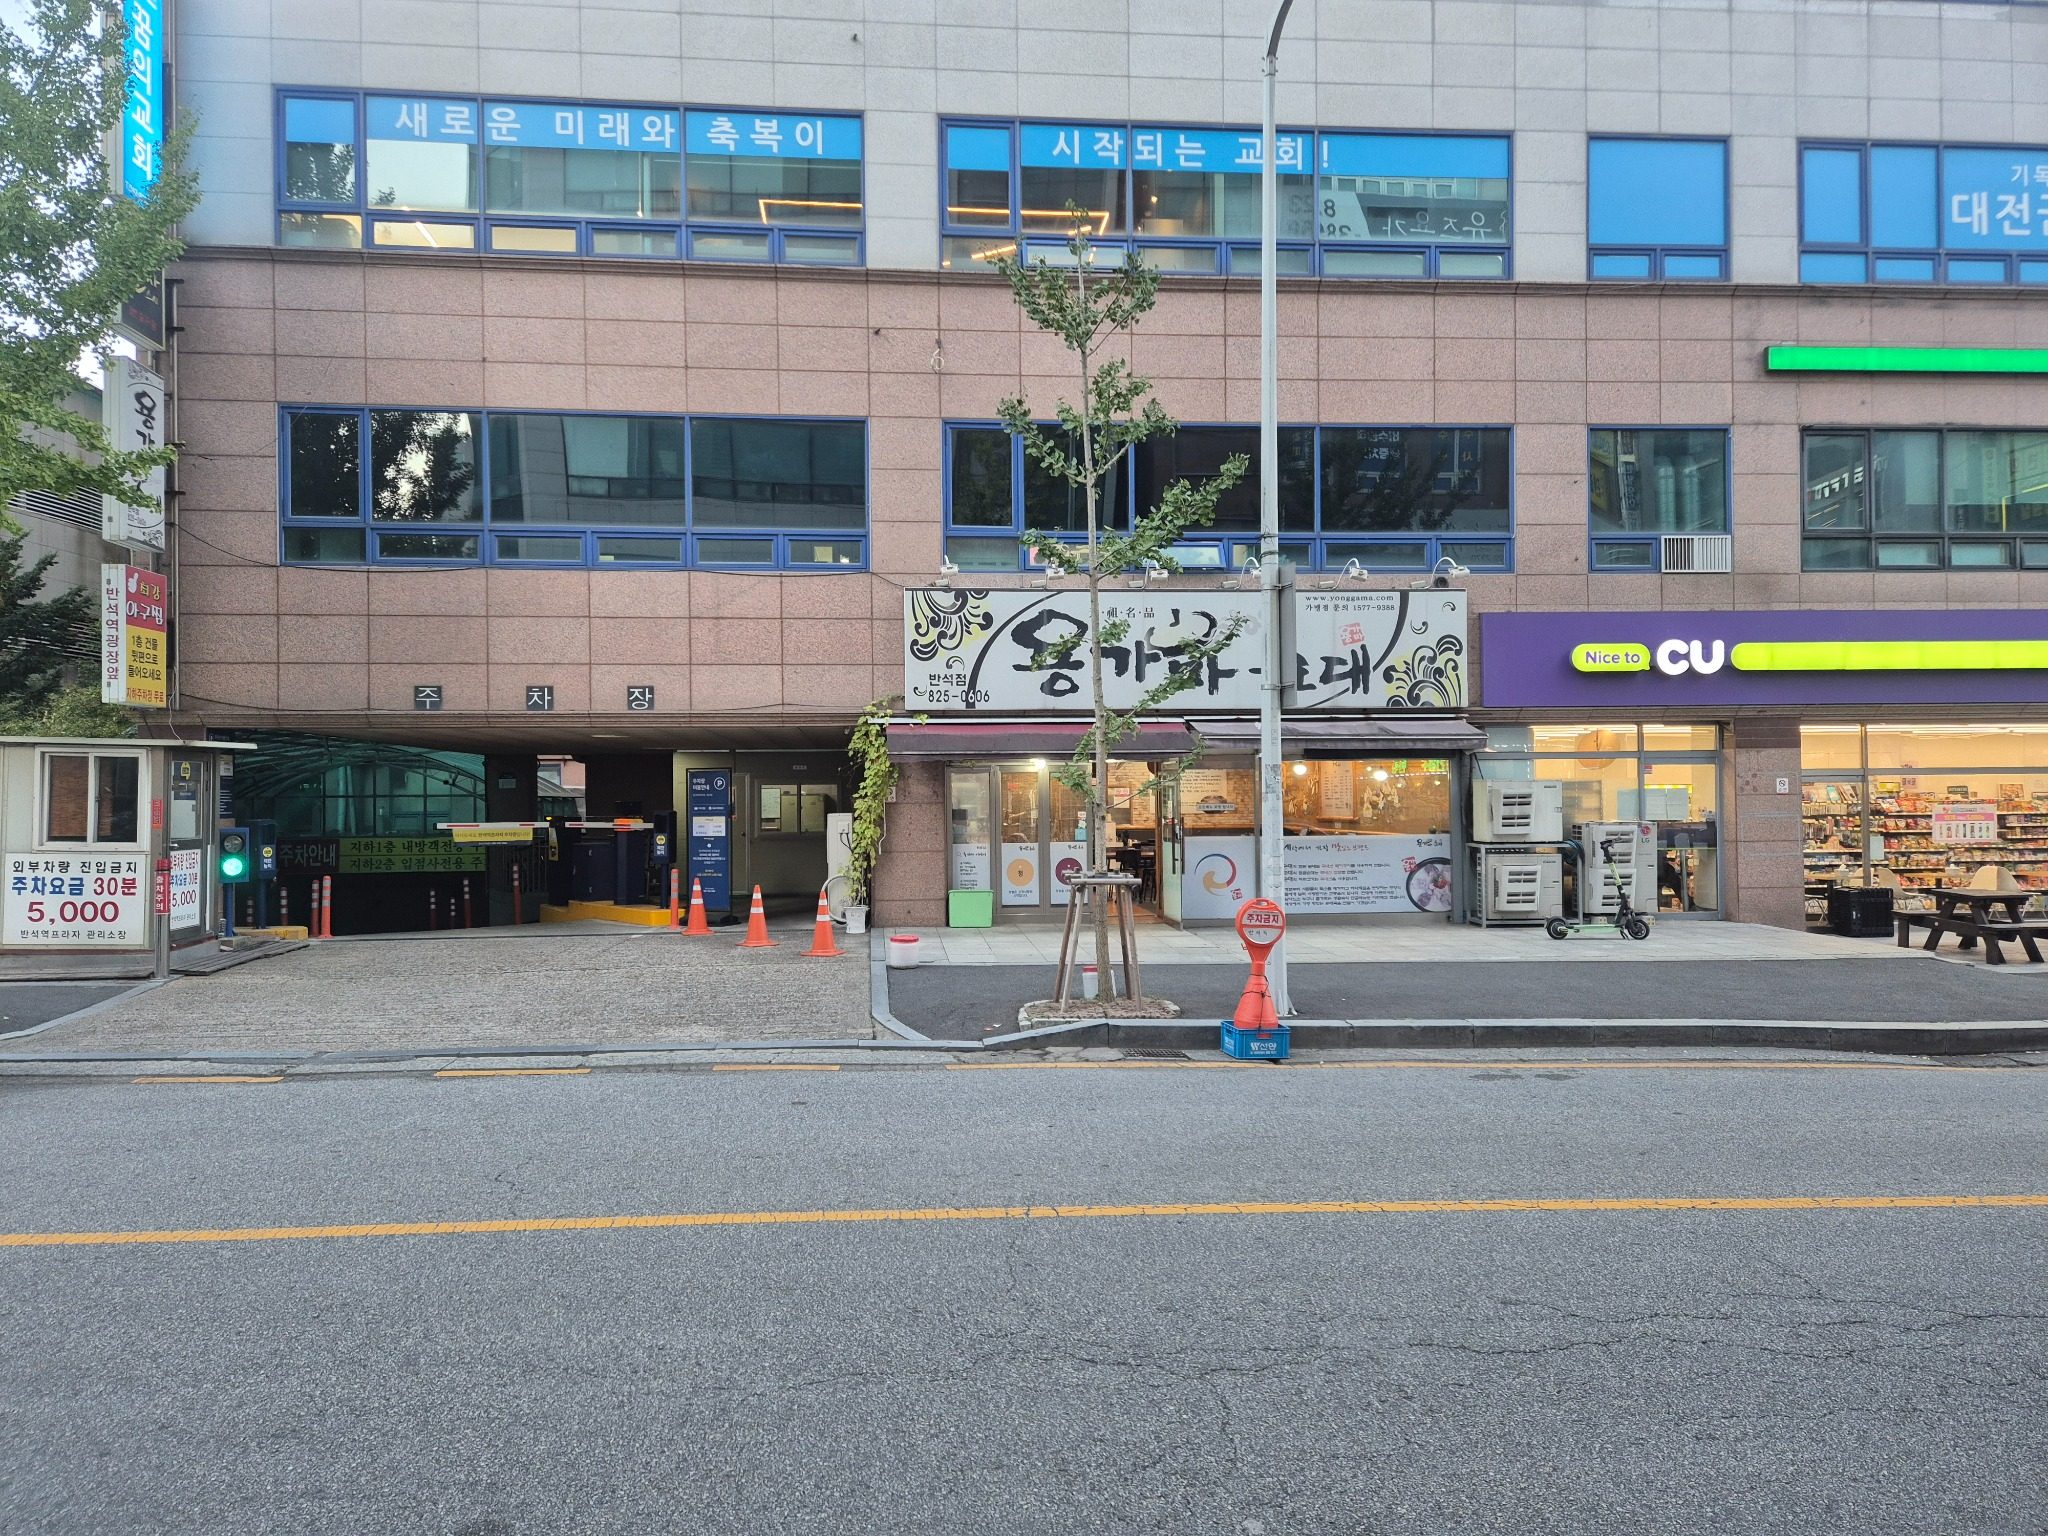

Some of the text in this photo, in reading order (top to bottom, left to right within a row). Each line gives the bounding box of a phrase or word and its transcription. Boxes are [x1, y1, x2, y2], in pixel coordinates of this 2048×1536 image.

[396, 103, 824, 156] 새로운 미래와 축복이
[1052, 129, 1331, 170] 시작되는 교회!
[126, 600, 164, 625] 아구찜
[1305, 604, 1329, 612] 가맹점
[1333, 604, 1349, 612] 문의
[105, 587, 119, 680] 반석역광장앞
[145, 637, 158, 651] 건물
[1011, 609, 1371, 698] 용가마대
[1585, 639, 1726, 675] Nice to CU
[128, 665, 162, 681] 들어오세요
[928, 673, 967, 686] 반석점
[928, 690, 990, 703] 825-0606
[279, 844, 336, 867] 주차안내
[351, 841, 396, 854] 지하1층
[12, 860, 138, 874] 외부차량 진입금지
[350, 857, 395, 871] 지하2층
[11, 876, 138, 897] 주차요금 30분
[171, 889, 197, 907] 5,000
[27, 901, 120, 926] 5,000
[20, 929, 127, 940] 반석역프라자 관리소장
